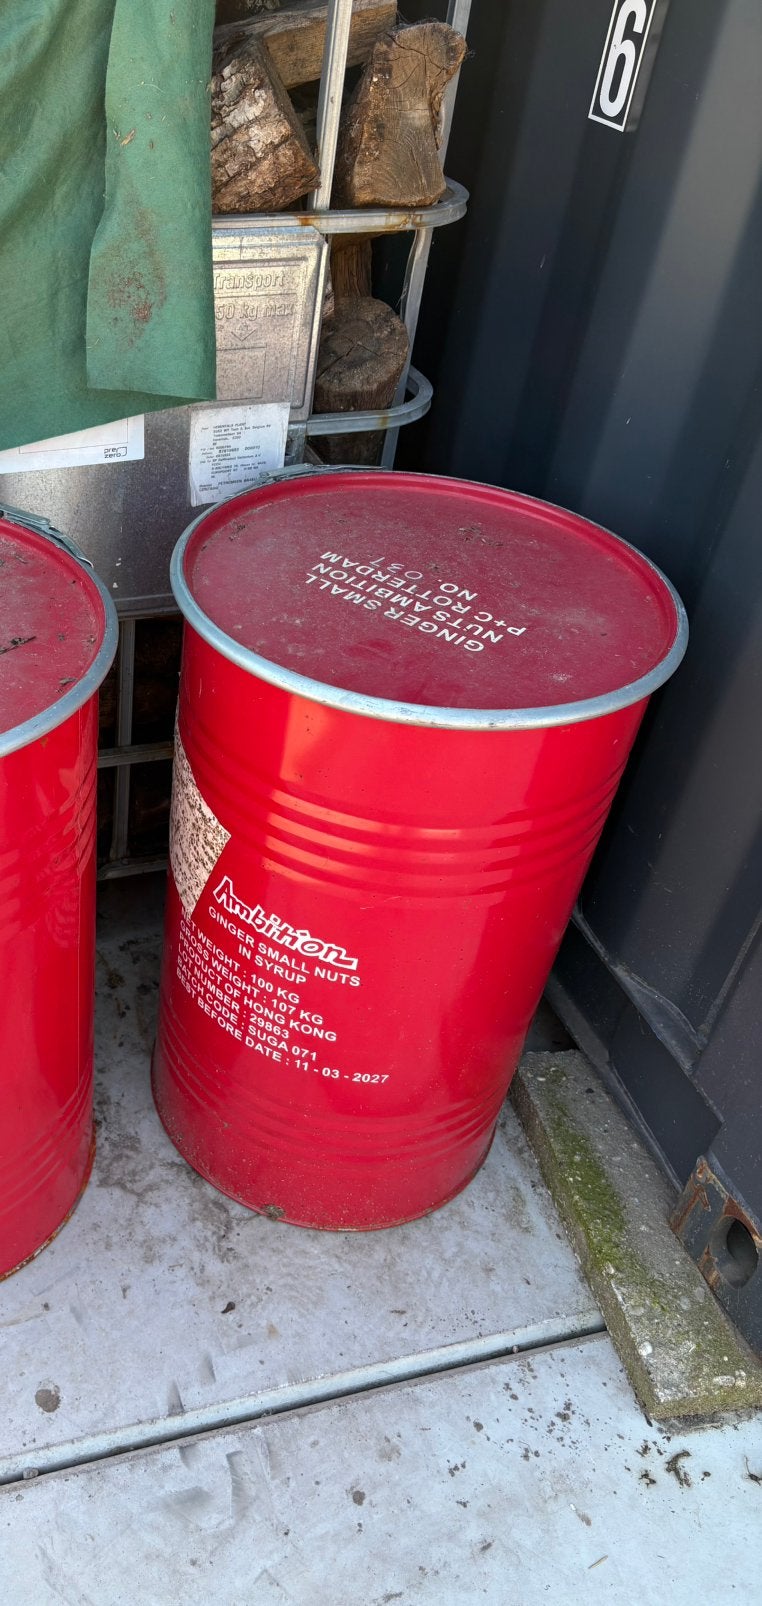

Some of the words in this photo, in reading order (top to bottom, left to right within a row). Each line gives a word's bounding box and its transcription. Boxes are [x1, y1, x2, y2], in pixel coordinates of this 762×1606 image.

[600, 0, 646, 117] 6
[213, 271, 285, 291] Transport
[240, 302, 259, 321] kg
[263, 303, 294, 316] max
[305, 573, 382, 610] SMALL
[312, 563, 433, 613] AMBITION
[320, 551, 471, 614] ROTTERDAM
[369, 557, 423, 580] 037
[437, 579, 478, 601] NO.
[384, 607, 485, 652] GINGER
[432, 610, 504, 643] NUTS
[474, 611, 527, 636] P+C
[208, 906, 254, 948] GINGER
[258, 942, 310, 974] SMALL
[314, 966, 361, 987] NUTS
[213, 876, 358, 970] Ambition
[178, 943, 193, 968] LOT
[194, 966, 240, 1013] NUMBER
[249, 1013, 290, 1039] 29863
[180, 920, 209, 961] GROSS
[212, 956, 260, 998] WEIGHT
[271, 999, 296, 1015] 107
[300, 1010, 324, 1025] KG
[180, 931, 222, 985] PRODUCT
[224, 983, 241, 998] OF
[243, 996, 285, 1025] HONG
[289, 1019, 337, 1042] KONG
[198, 928, 240, 972] WEIGHT
[250, 974, 274, 993] 100
[277, 985, 300, 1004] KG
[238, 944, 251, 960] IN
[254, 954, 307, 985] SYRUP
[176, 966, 196, 999] BEST
[197, 998, 243, 1042] BEFORE
[245, 1037, 282, 1063] DATE
[295, 1059, 309, 1071] 11
[322, 1067, 340, 1079] 03
[352, 1072, 390, 1084] 2027
[177, 955, 204, 996] BATCH
[206, 993, 238, 1030] CODE
[248, 1025, 289, 1052] SUGA
[291, 1045, 317, 1061] 071
